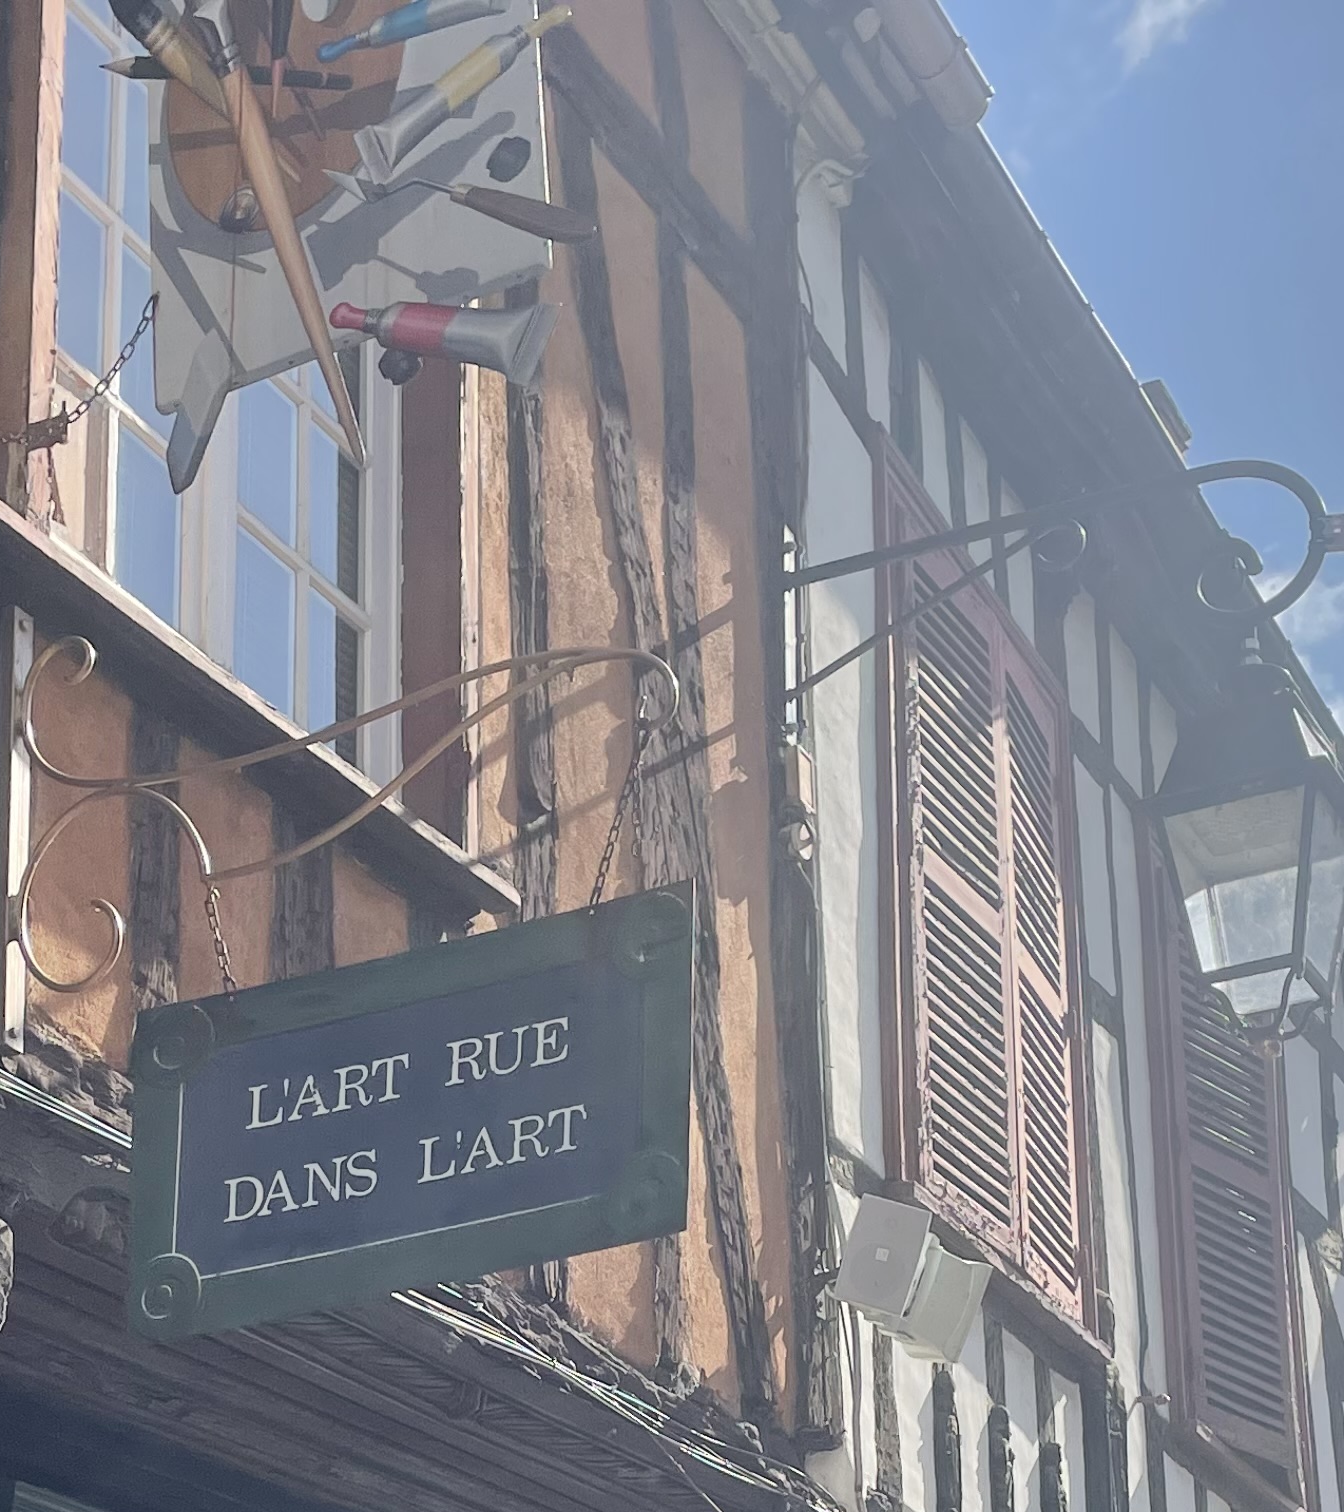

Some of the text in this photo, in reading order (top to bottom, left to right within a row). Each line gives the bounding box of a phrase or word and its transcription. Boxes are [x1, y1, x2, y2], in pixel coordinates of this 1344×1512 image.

[246, 1016, 571, 1130] L'ART RUE
[223, 1104, 587, 1224] DANS L'ART
